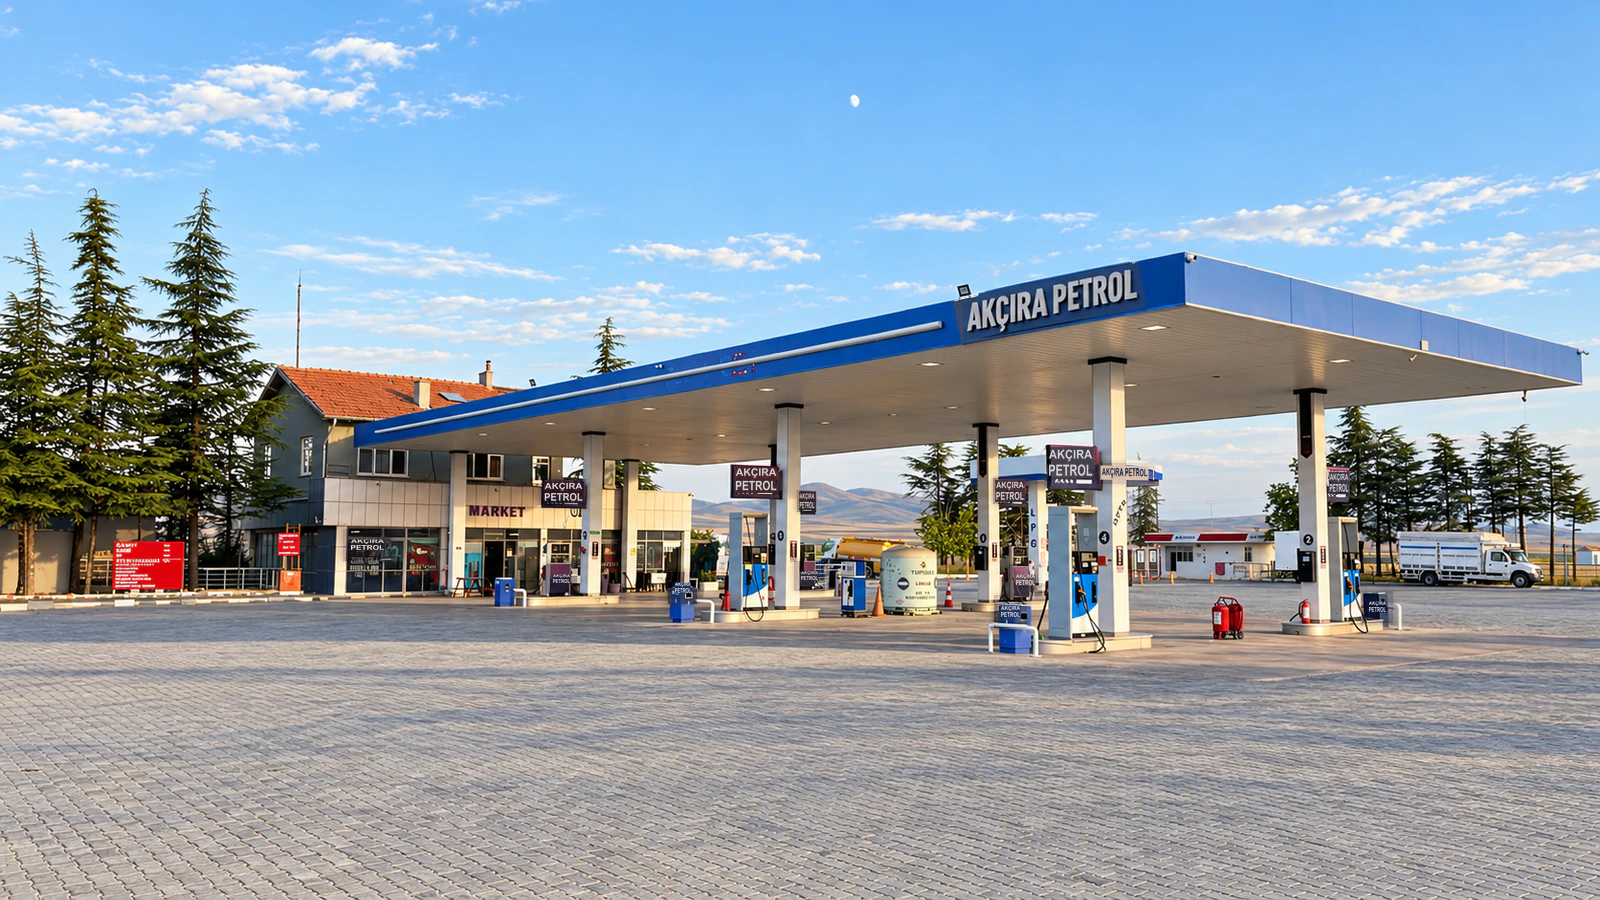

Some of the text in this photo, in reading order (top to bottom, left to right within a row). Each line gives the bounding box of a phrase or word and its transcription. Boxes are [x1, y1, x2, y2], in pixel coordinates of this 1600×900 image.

[967, 269, 1138, 332] AKÇIRA PETROL
[1049, 449, 1093, 462] AKÇIRA
[735, 467, 777, 479] AKÇIRA
[1048, 464, 1093, 477] PETROL
[1102, 467, 1148, 479] AKÇIRA PETROL
[1329, 473, 1349, 482] AKÇIRA
[544, 482, 583, 491] AKÇIRA
[735, 480, 777, 491] PETROL
[996, 481, 1025, 490] AKÇIRA
[1329, 483, 1349, 493] PETROL
[544, 492, 583, 502] PETROL
[799, 493, 815, 501] AKÇIRA
[995, 491, 1025, 501] PETROL
[469, 505, 526, 518] MARKET
